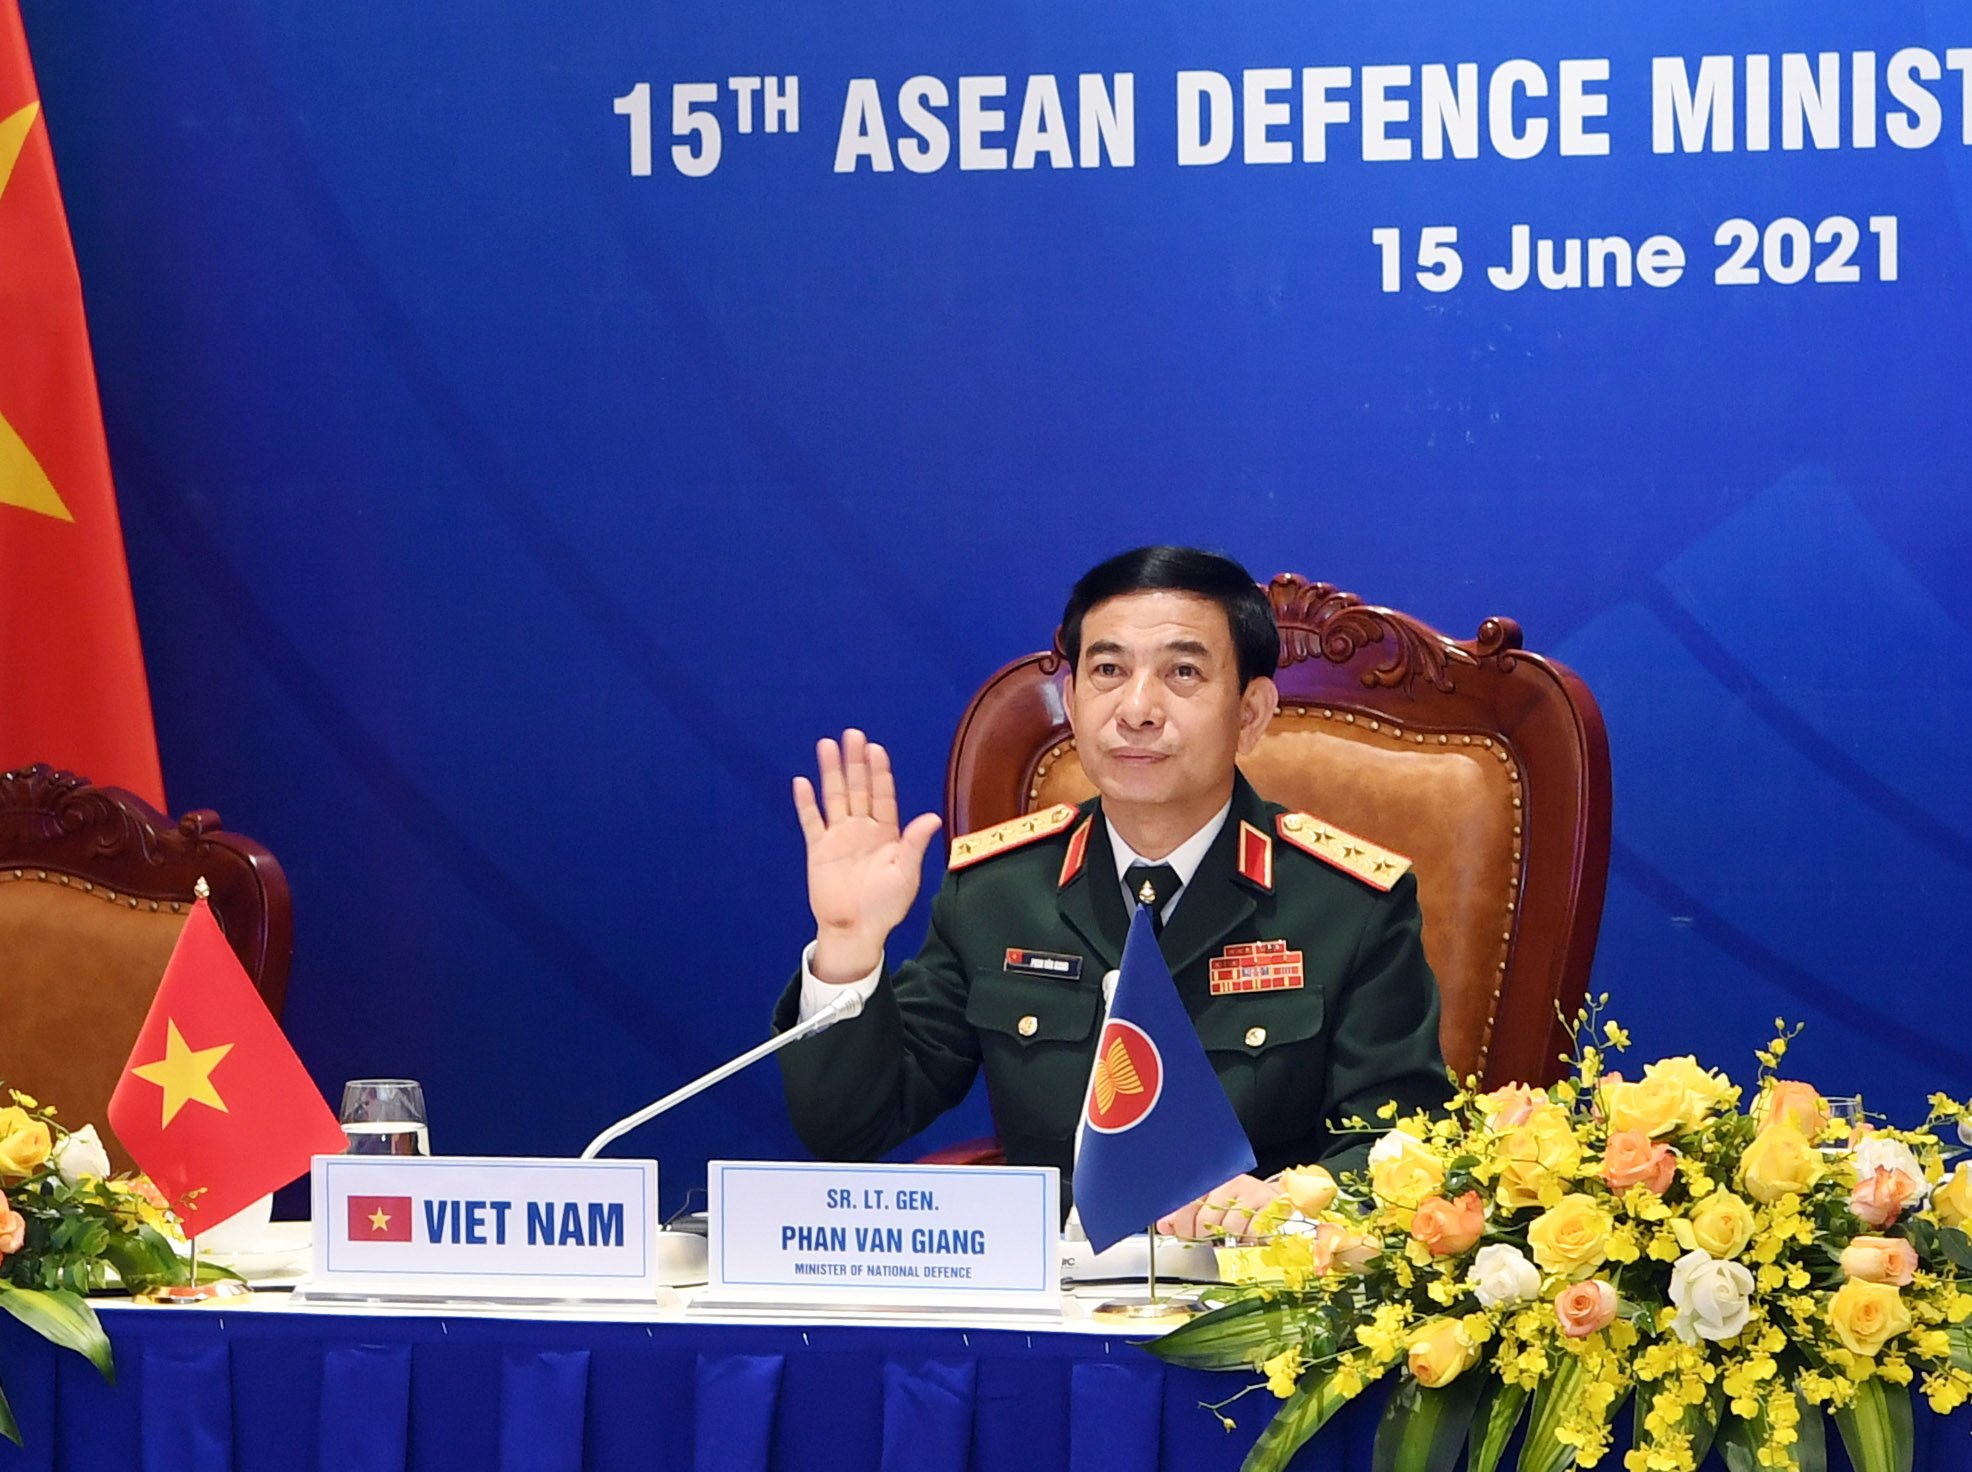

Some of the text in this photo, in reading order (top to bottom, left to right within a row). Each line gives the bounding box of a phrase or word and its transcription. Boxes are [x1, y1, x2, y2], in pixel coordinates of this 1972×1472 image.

[614, 76, 798, 176] 15TH
[834, 73, 1134, 172] ASEAN
[1177, 59, 1609, 165] DEFENCE
[1373, 216, 1897, 292] 15 June 2021
[826, 1188, 939, 1211] SR. LT. GEN.
[424, 1200, 624, 1246] VIET NAM
[781, 1225, 985, 1255] PHAN VAN GIANG
[794, 1263, 971, 1279] MINISTER OF NATIONAL DEFENCE
